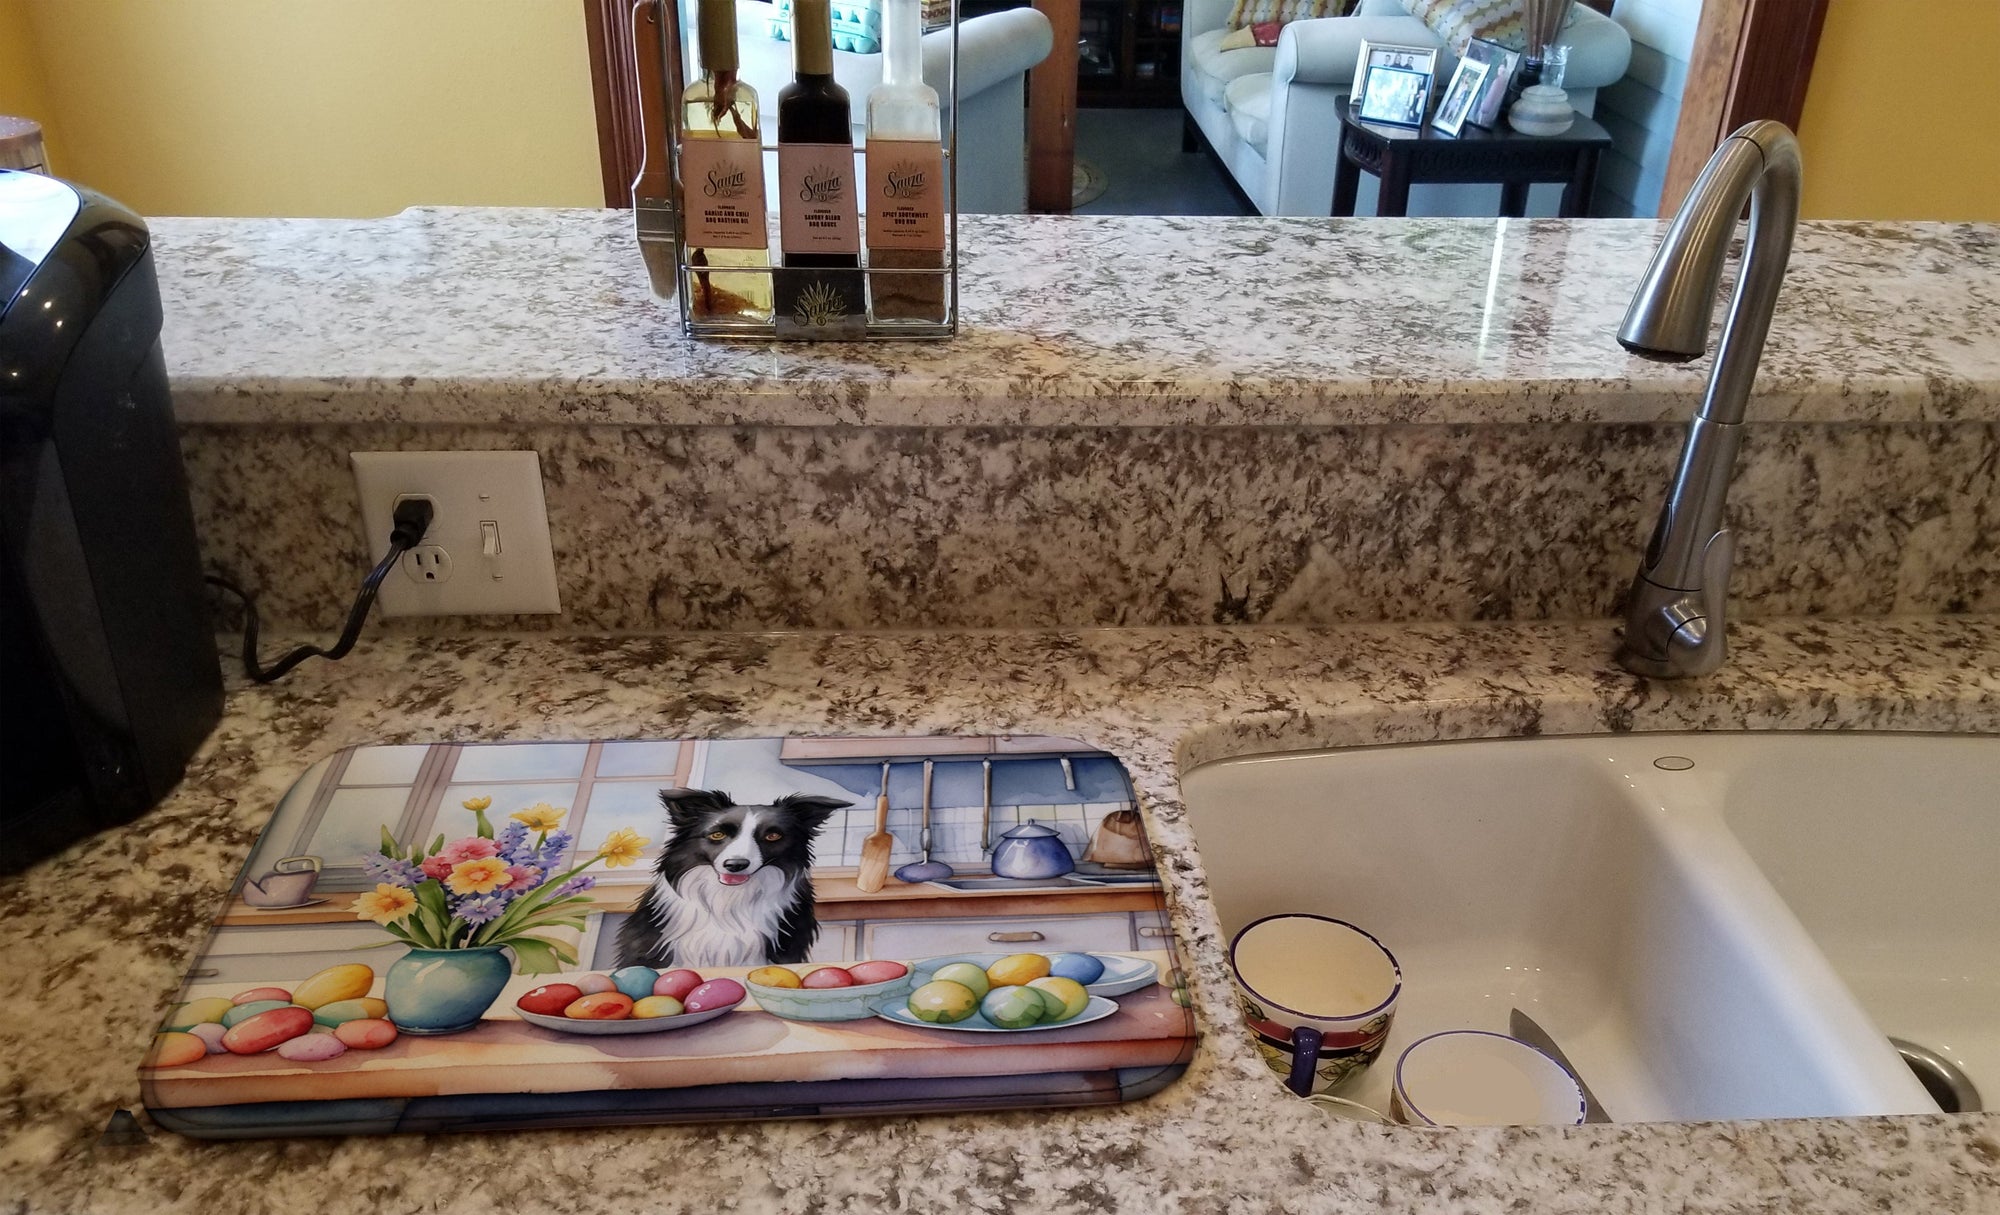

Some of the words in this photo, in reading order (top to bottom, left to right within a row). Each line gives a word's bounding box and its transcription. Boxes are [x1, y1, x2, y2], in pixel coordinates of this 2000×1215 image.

[704, 170, 746, 197] Sauza
[800, 176, 842, 202] Sauza
[884, 172, 926, 198] Sauza
[792, 295, 843, 326] Sauza
